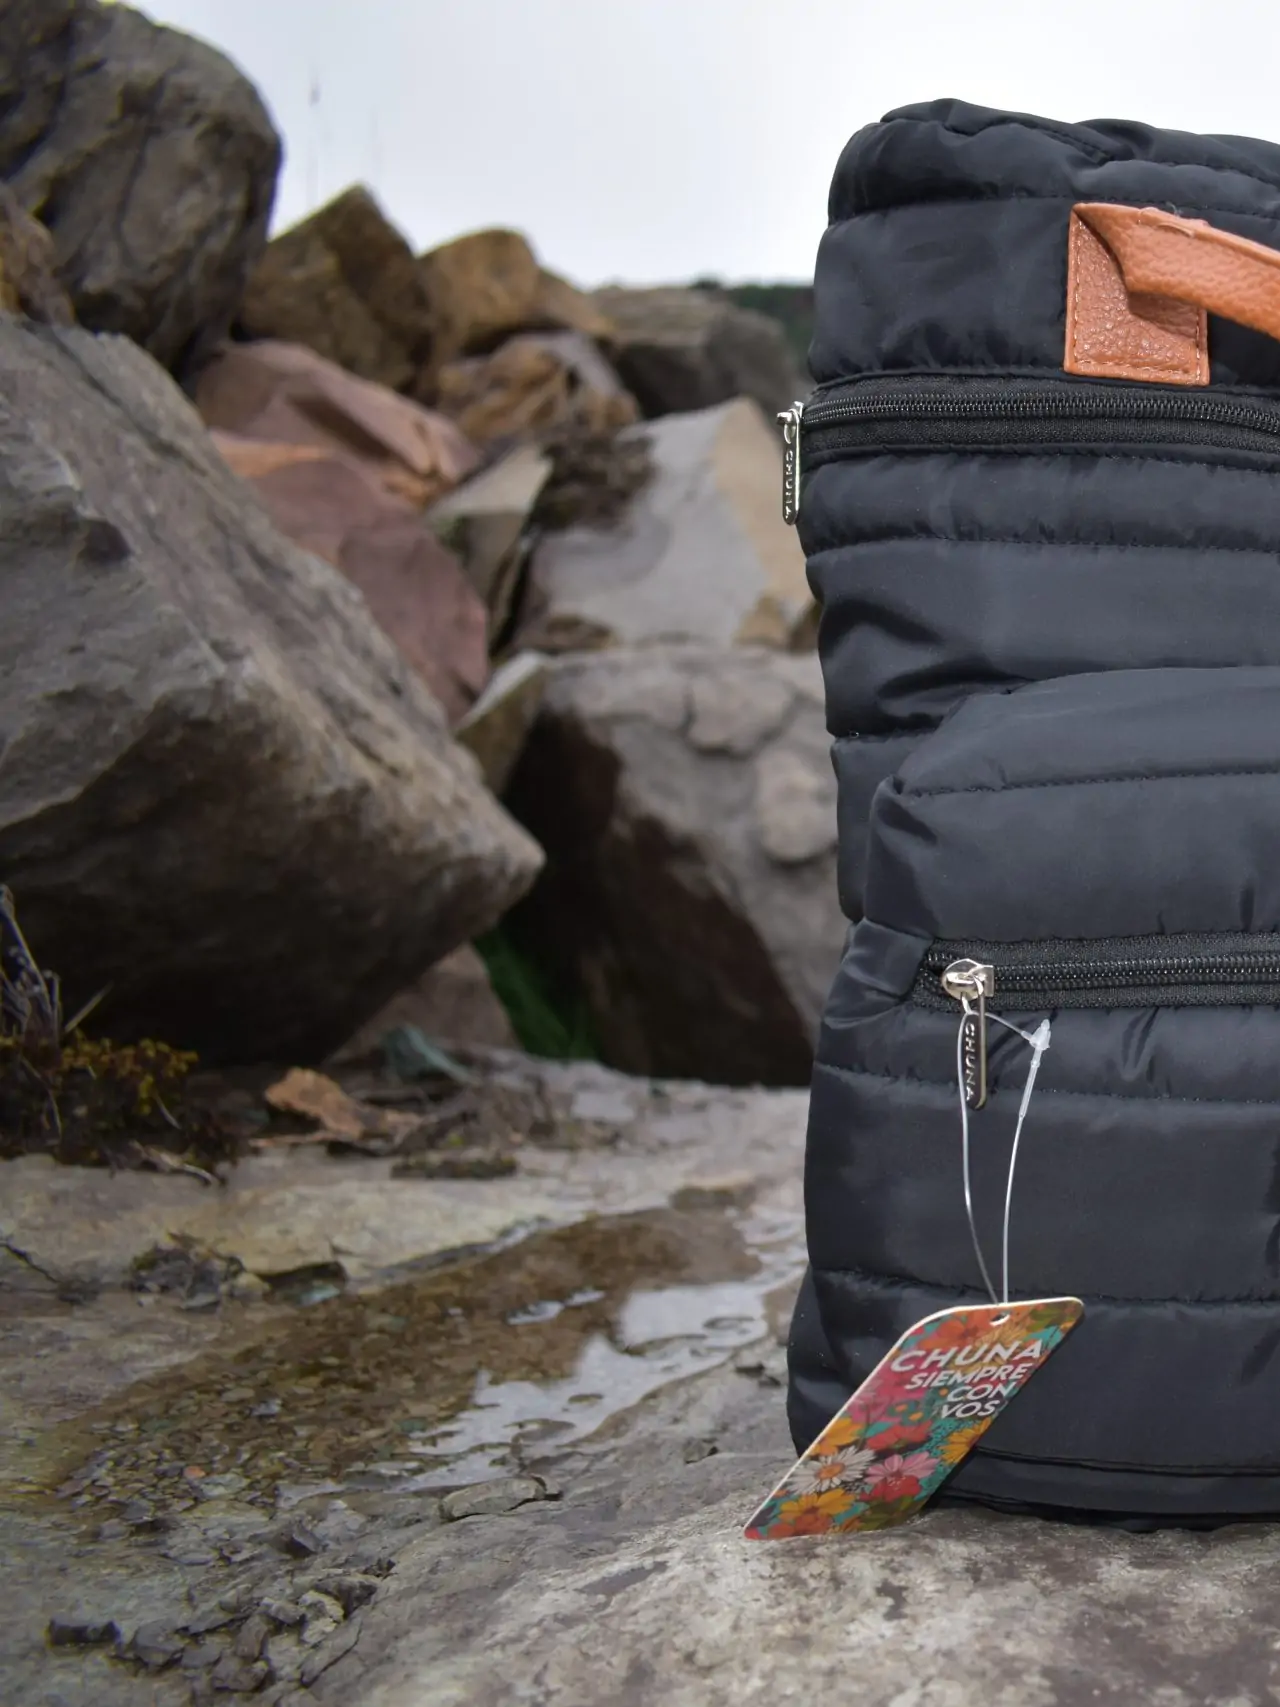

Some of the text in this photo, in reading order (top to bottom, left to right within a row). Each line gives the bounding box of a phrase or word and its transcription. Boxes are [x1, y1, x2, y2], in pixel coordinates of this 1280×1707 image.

[965, 1022, 976, 1102] CHUNA
[889, 1339, 1044, 1373] CHUNA
[903, 1362, 1034, 1390] SIEMPRE
[946, 1381, 1018, 1402] CON
[940, 1399, 1001, 1419] VOS
